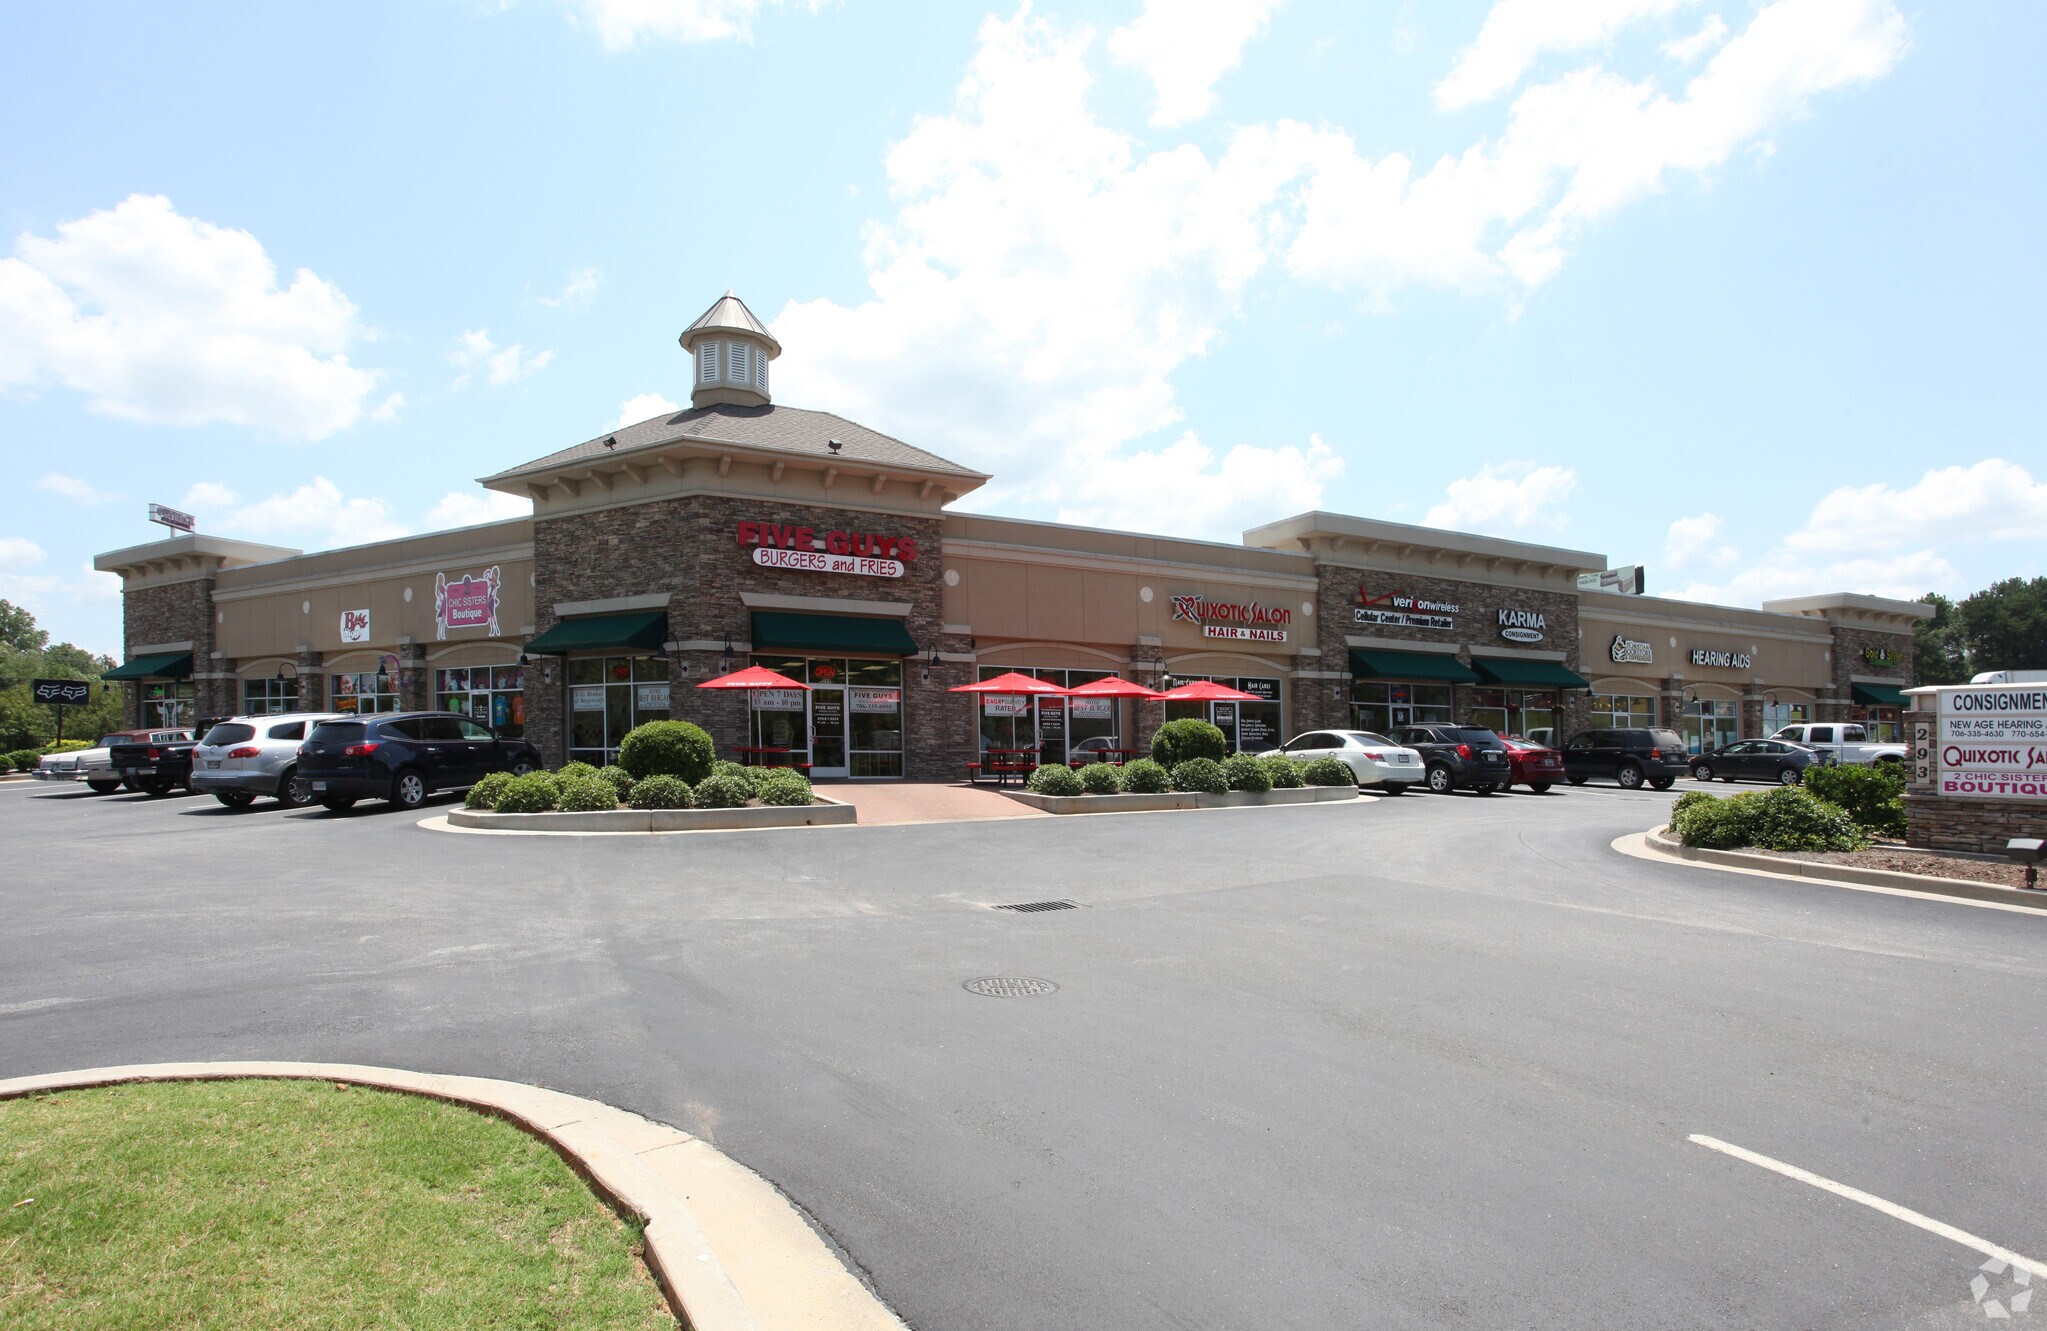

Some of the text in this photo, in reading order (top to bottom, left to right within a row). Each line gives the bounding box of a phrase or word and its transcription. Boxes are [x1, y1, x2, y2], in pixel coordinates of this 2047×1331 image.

[738, 520, 917, 561] FIVE GUYS
[760, 550, 897, 576] BURGERS and FRIES
[449, 595, 487, 608] CHIC SISTERS
[452, 608, 482, 620] Boutique
[1248, 602, 1291, 624] SALON
[1355, 610, 1379, 622] Cellular
[1380, 613, 1401, 624] Center
[1405, 615, 1430, 627] Premium
[1430, 617, 1453, 628] Retailer
[1499, 609, 1546, 629] KARMA
[1208, 627, 1238, 638] HAIR
[1249, 629, 1284, 641] NAILS
[1504, 630, 1540, 640] CONSIGNMENT
[1692, 650, 1750, 668] HEARING AIDS
[783, 691, 802, 699] DAYS
[1950, 721, 1971, 729] NEW
[1974, 720, 1994, 729] AGE
[1997, 720, 2043, 729] HEARING
[1943, 746, 2047, 769] QUIXOTIC SA
